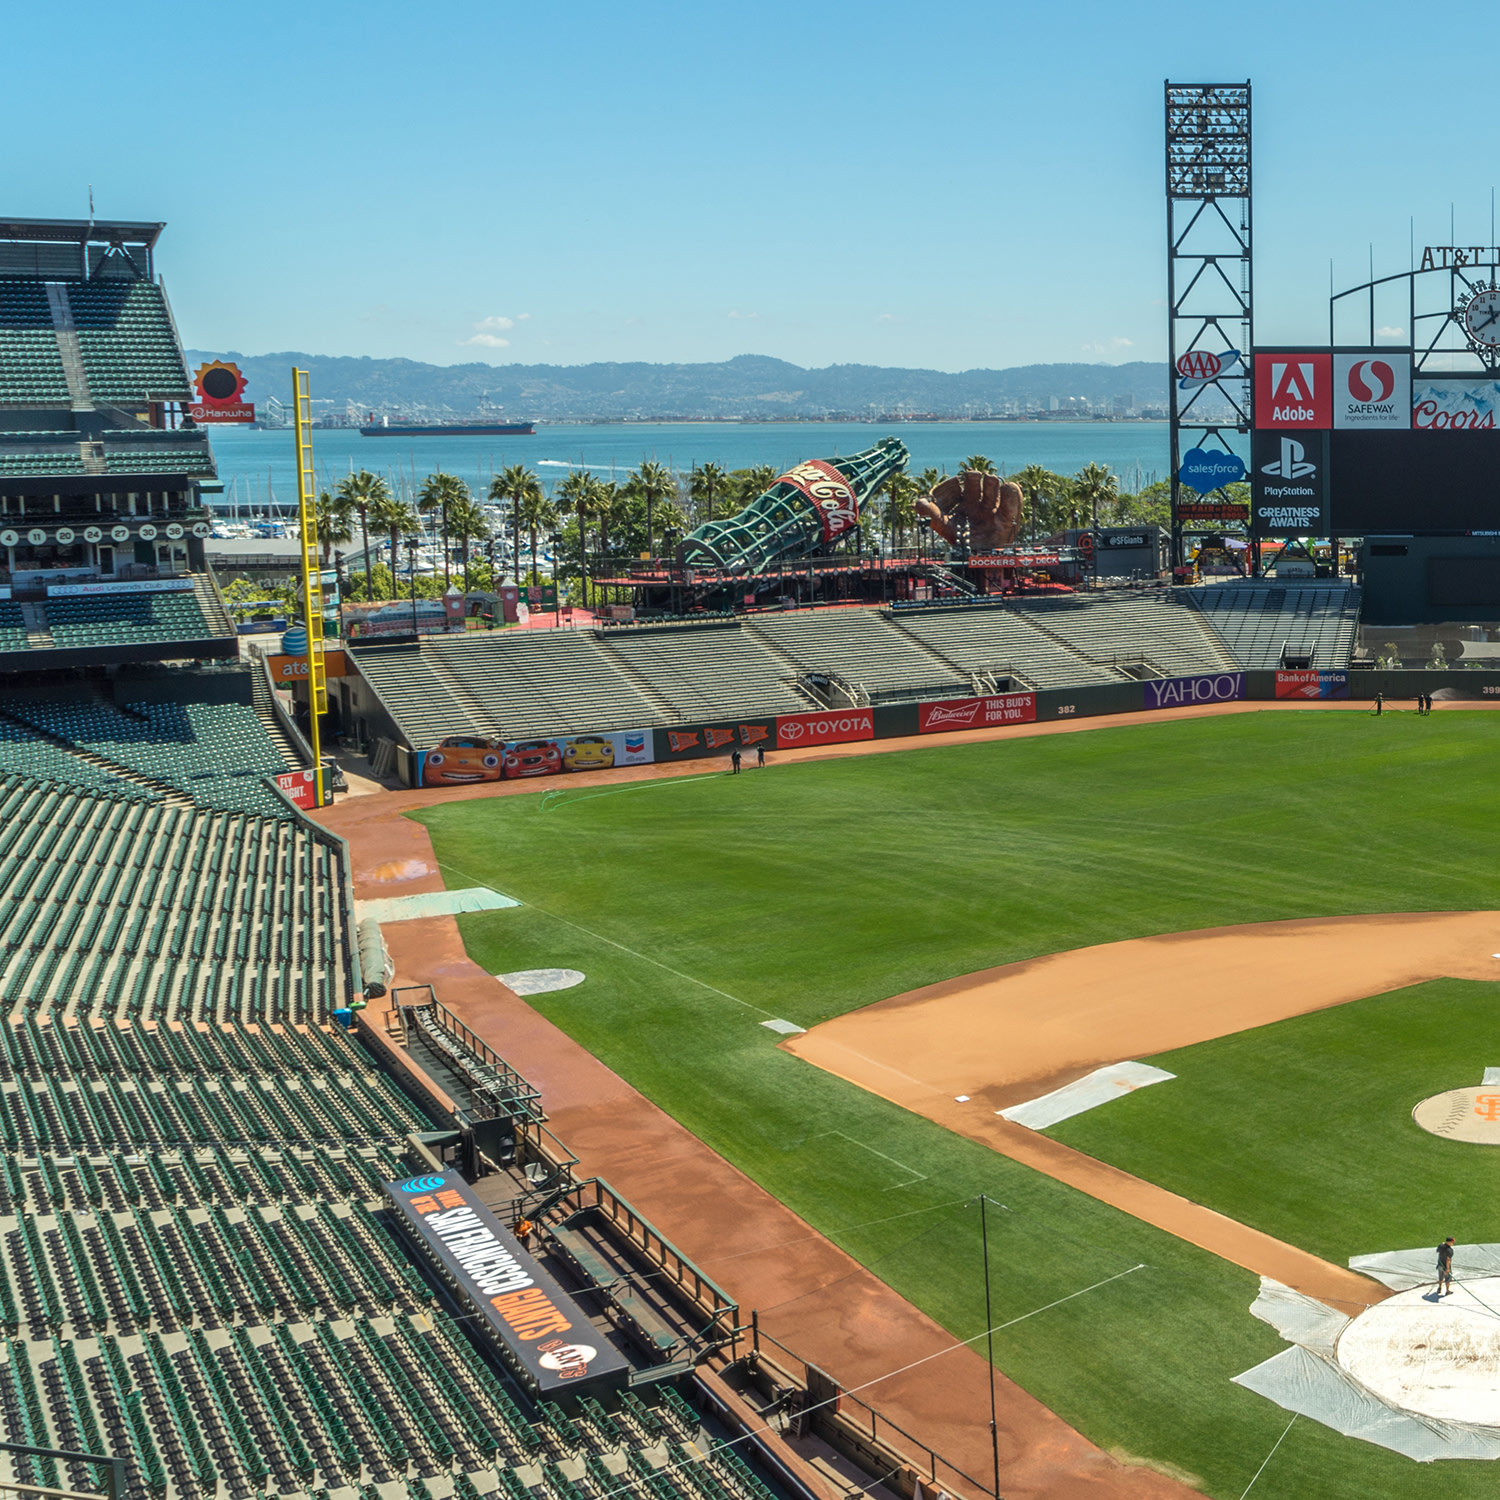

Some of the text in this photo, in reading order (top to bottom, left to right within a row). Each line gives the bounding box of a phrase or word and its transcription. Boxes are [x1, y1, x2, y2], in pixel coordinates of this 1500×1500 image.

[1420, 246, 1485, 272] AT&T
[1453, 292, 1470, 324] SAN
[1181, 352, 1219, 378] AAA
[205, 409, 252, 418] Hanwha
[1272, 405, 1315, 421] Adobe
[1347, 404, 1395, 414] SAFEWAY
[1413, 400, 1497, 430] Coors
[1344, 414, 1378, 422] Ingredients
[1188, 463, 1239, 476] salesforce
[1264, 486, 1313, 498] PlayStation
[1258, 507, 1320, 518] GREATNESS
[169, 527, 181, 535] 36
[194, 526, 208, 534] 44
[5, 534, 12, 542] 4
[33, 533, 41, 541] 11
[1109, 535, 1144, 545] @SFGiants
[970, 557, 1058, 566] DOCKERS DECK
[82, 584, 105, 592] Audi
[106, 583, 142, 592] Legends
[1277, 673, 1346, 683] Bank of America
[1150, 673, 1241, 707] YAHOO!
[1482, 686, 1500, 694] 399
[985, 696, 1032, 710] THIS BUD'S
[931, 709, 976, 721] Budweiser
[985, 709, 1023, 722] FOR YOU.
[1057, 705, 1076, 715] 382
[806, 717, 872, 735] TOYOTA
[280, 775, 293, 789] FLY
[424, 1206, 573, 1341] SAN FRANCISCO GIANTS
[536, 1338, 587, 1379] GIANTS
